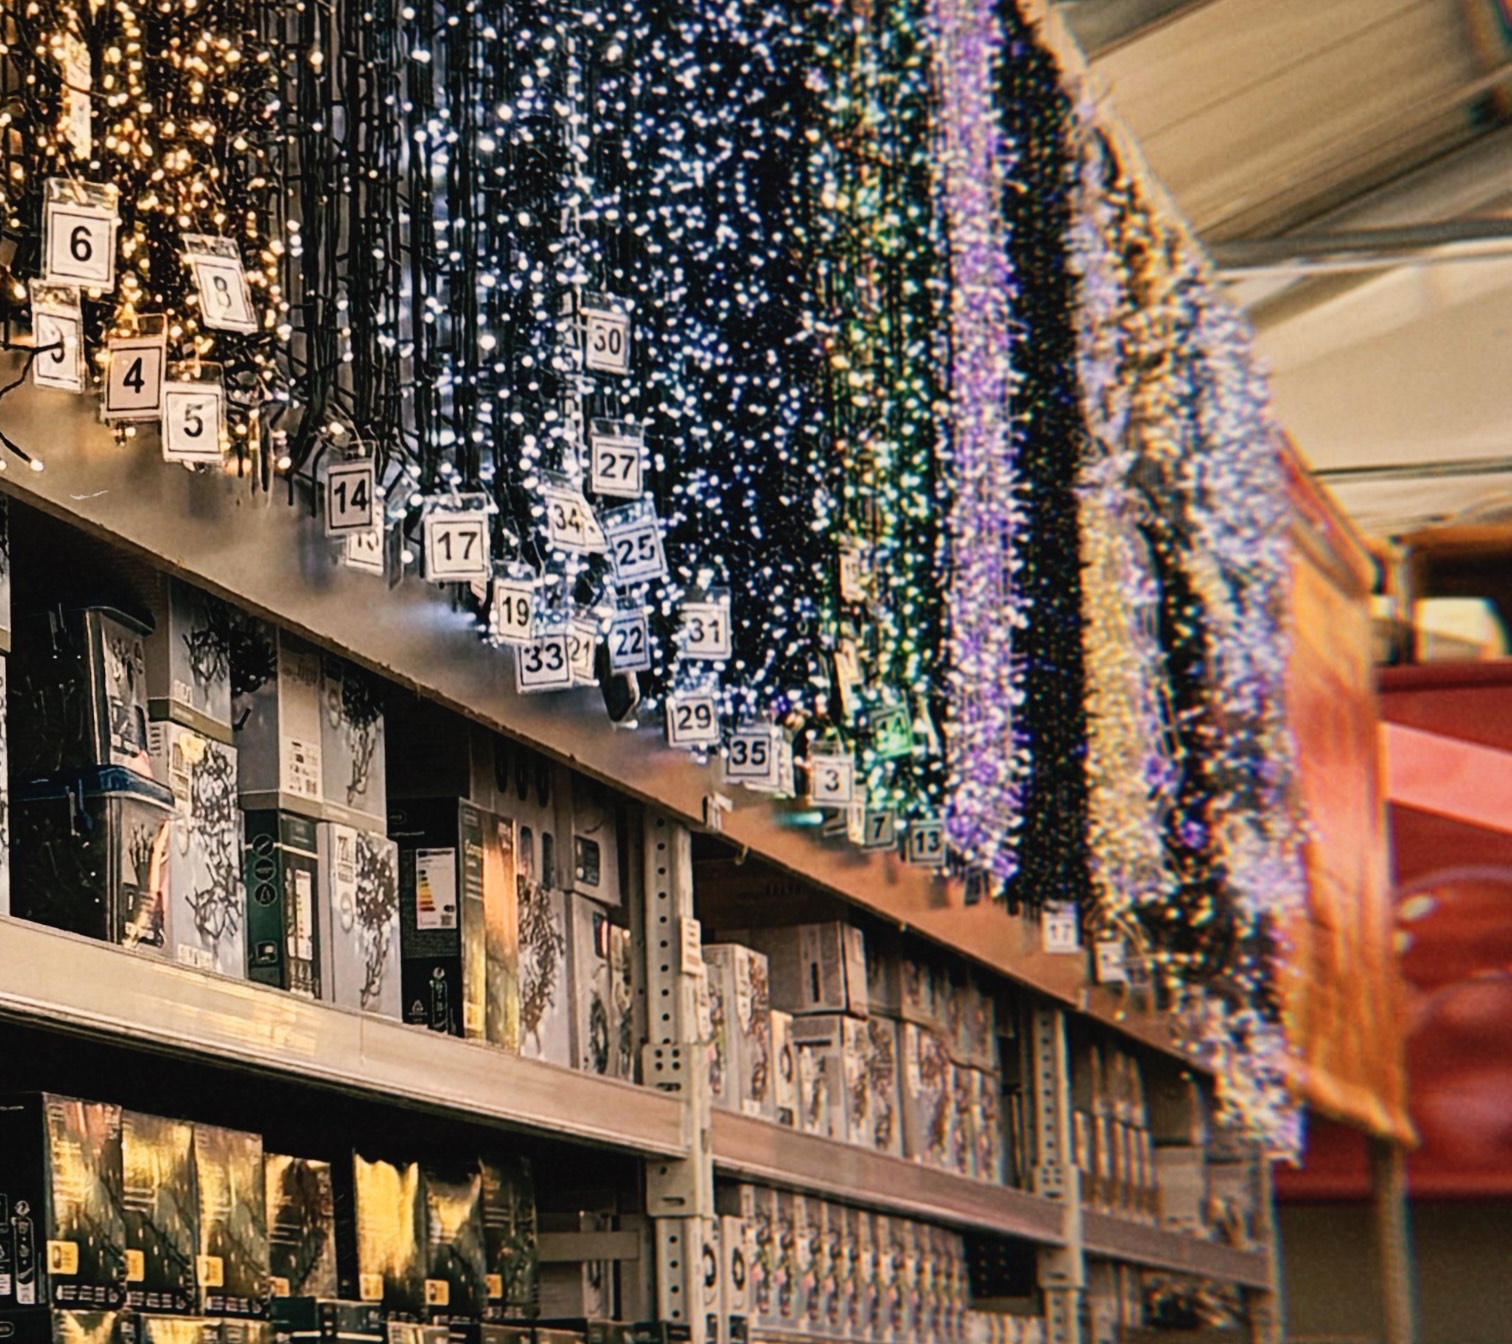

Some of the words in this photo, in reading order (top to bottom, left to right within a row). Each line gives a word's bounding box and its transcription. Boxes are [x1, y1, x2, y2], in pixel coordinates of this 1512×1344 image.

[70, 225, 93, 262] 6
[593, 324, 621, 355] 30
[122, 356, 145, 394] 4
[183, 403, 204, 438] 5
[599, 452, 636, 480] 27
[333, 478, 369, 514] 14
[437, 531, 479, 561] 17
[616, 535, 656, 566] 25
[502, 595, 530, 627] 19
[615, 625, 644, 657] 22
[688, 618, 721, 644] 31
[524, 641, 564, 673] 33
[677, 703, 712, 731] 29
[731, 740, 767, 766] 35
[824, 769, 840, 792] 3
[873, 816, 886, 839] 7
